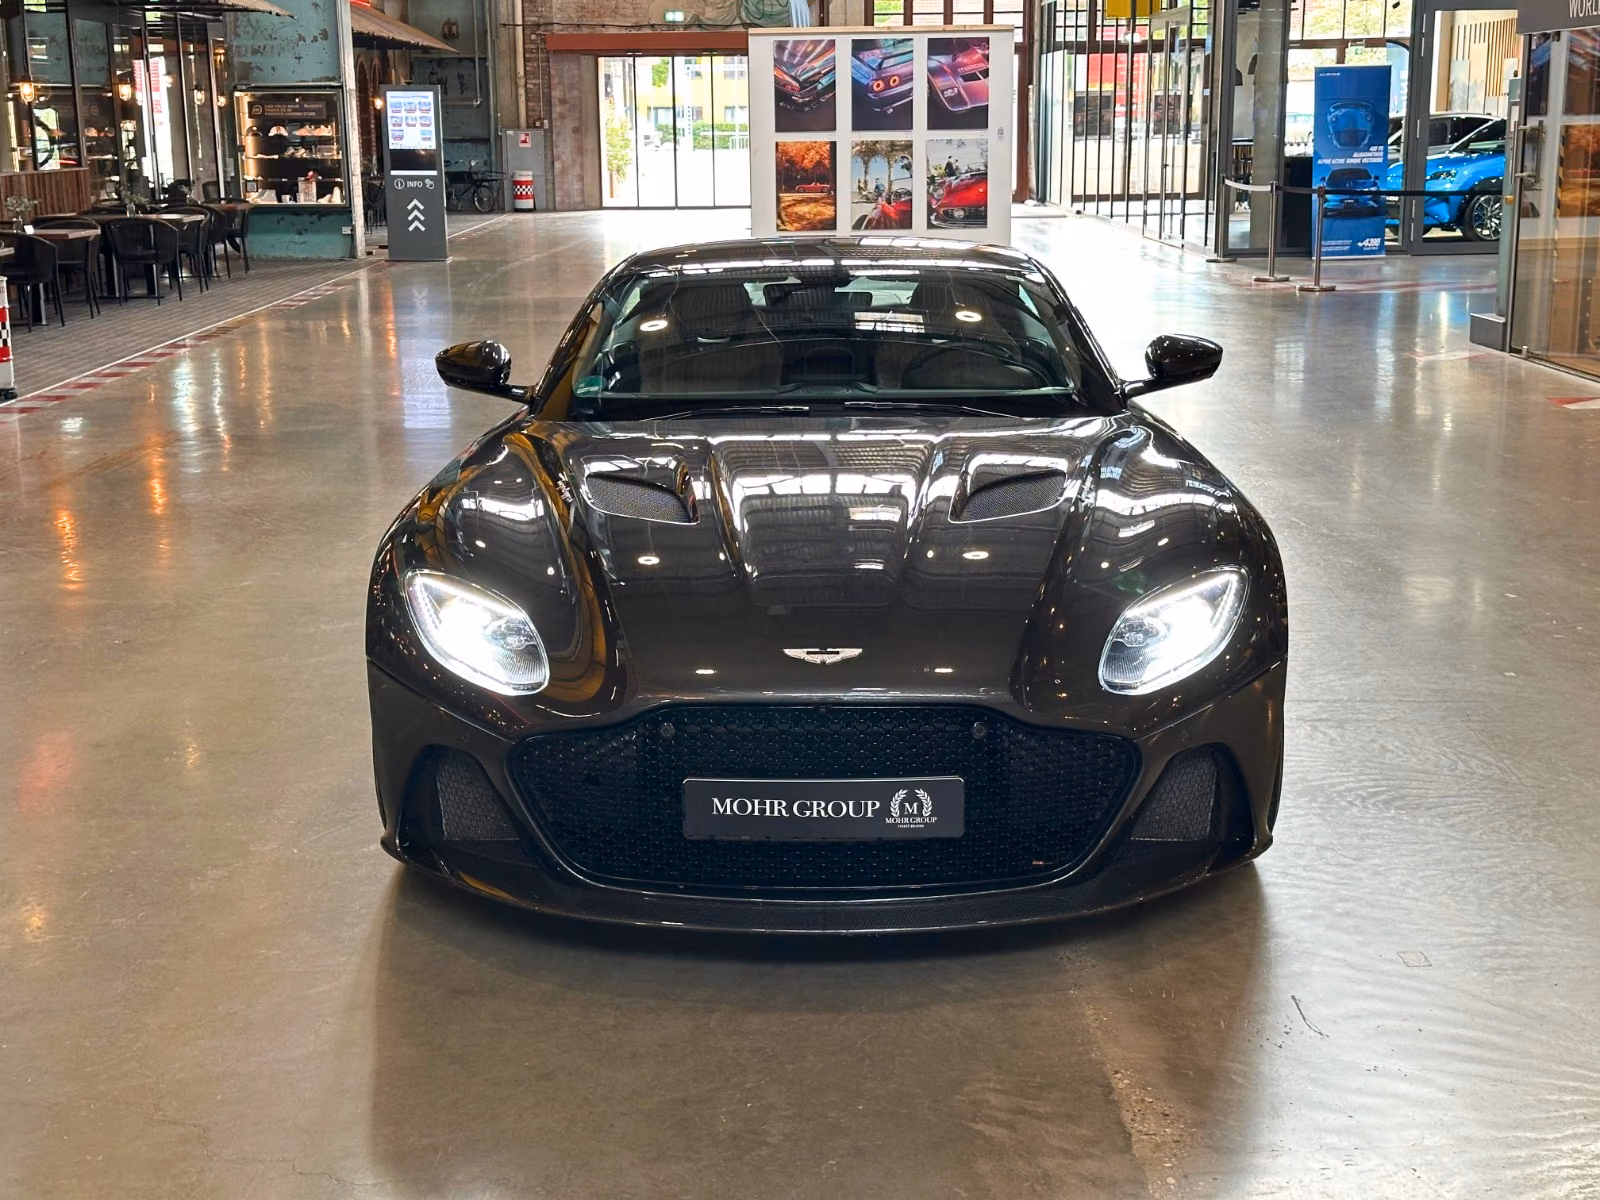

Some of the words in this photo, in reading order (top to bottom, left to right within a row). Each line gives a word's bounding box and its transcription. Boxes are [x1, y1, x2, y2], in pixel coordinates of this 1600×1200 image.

[1569, 0, 1600, 18] WORL
[406, 180, 423, 188] INFO
[711, 797, 789, 817] MOHR
[792, 799, 881, 818] GROUP
[903, 802, 919, 815] M
[885, 816, 910, 824] MOHR
[909, 816, 938, 824] GROUP
